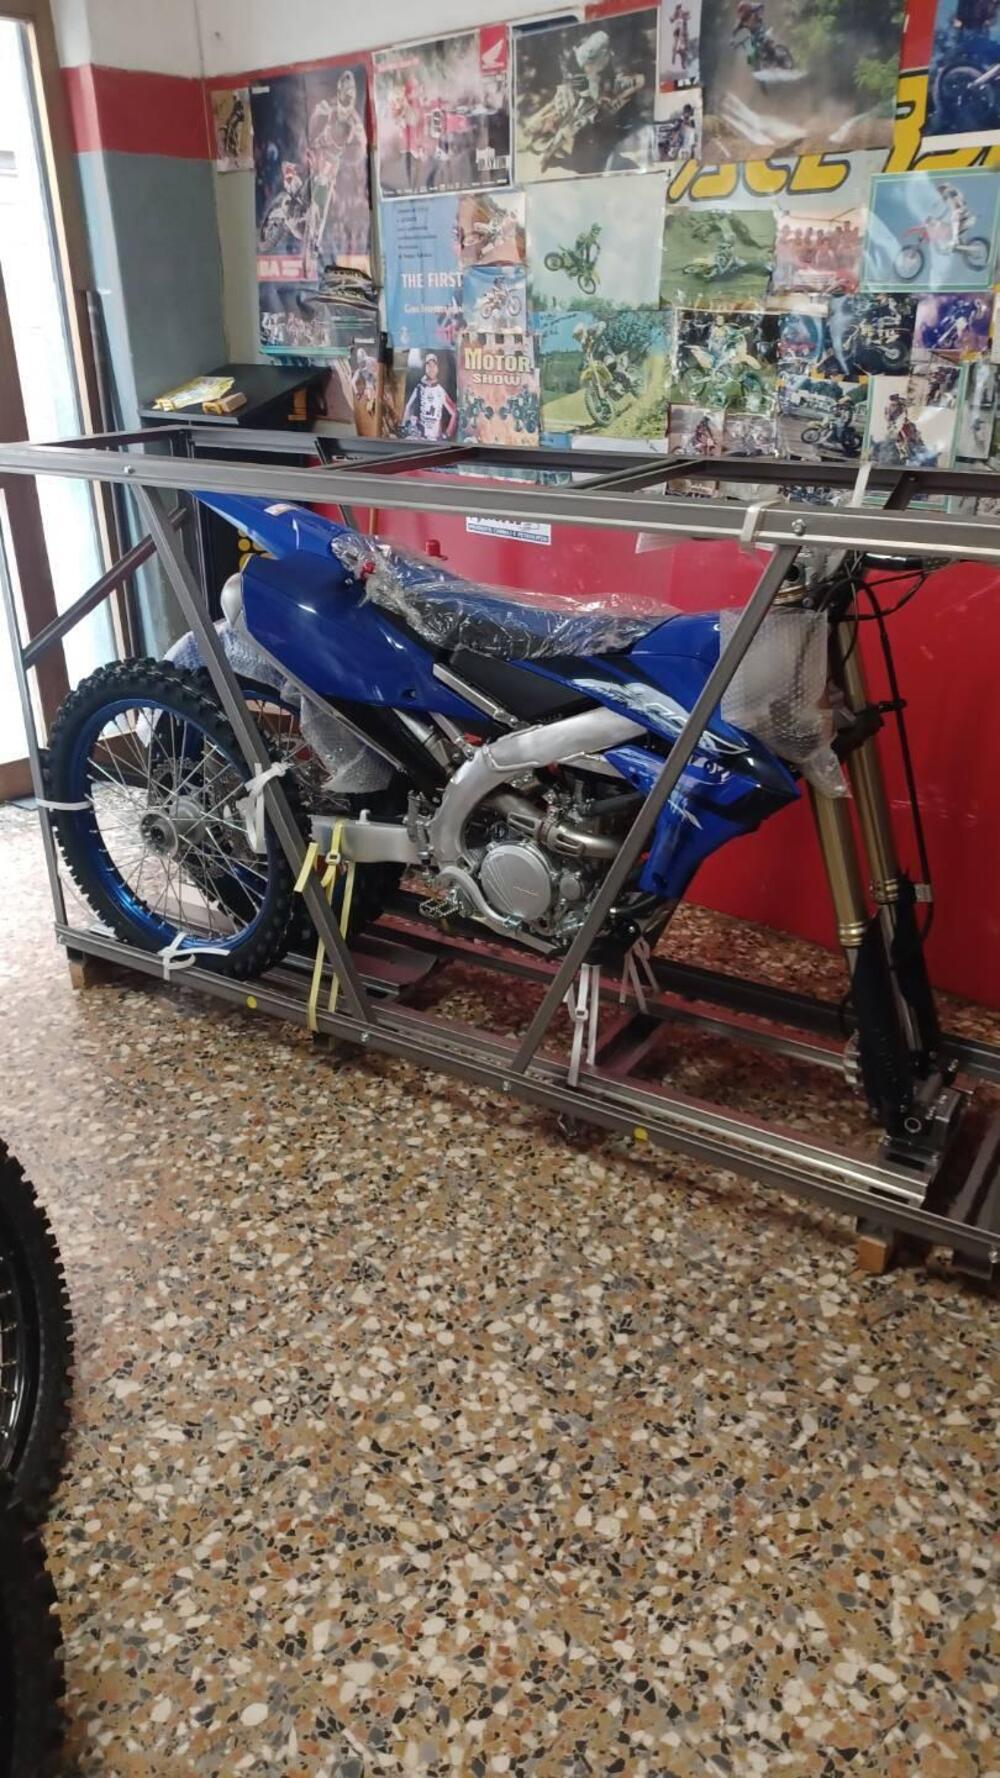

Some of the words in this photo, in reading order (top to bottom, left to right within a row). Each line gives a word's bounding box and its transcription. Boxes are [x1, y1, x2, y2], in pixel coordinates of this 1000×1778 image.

[402, 273, 424, 288] THE
[428, 272, 464, 288] FIRST
[464, 347, 531, 372] MOTOR
[473, 373, 521, 386] SHOW
